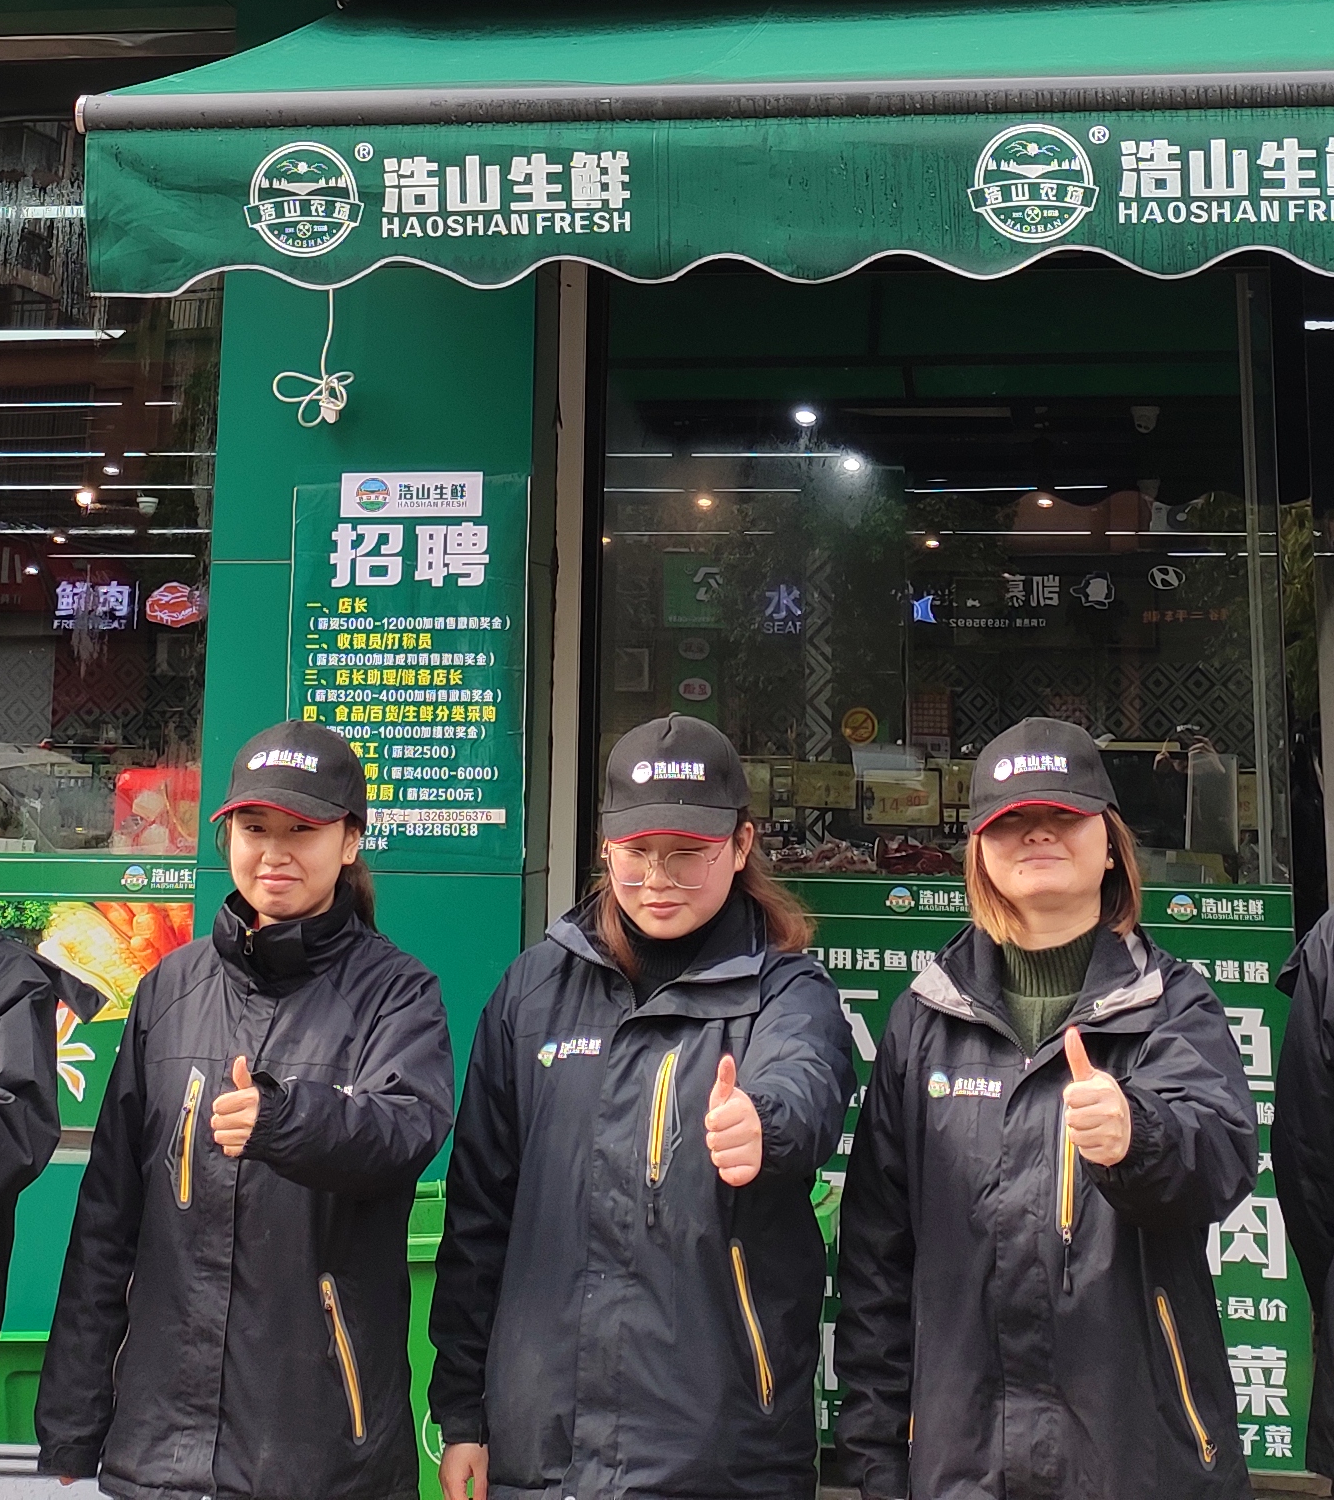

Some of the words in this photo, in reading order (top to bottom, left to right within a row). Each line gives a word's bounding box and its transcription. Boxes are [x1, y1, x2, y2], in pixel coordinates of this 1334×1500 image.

[380, 150, 632, 214] 浩山生鲜
[398, 483, 467, 500] 浩山生鲜
[330, 522, 490, 587] 招聘
[306, 598, 368, 615] 一、店长
[304, 668, 463, 686] 三、店长助理/储备店长
[150, 868, 197, 884] 浩山生
[919, 889, 970, 907] 浩山生
[1201, 897, 1264, 916] 浩山生鲜
[1227, 1344, 1291, 1417] 菜
